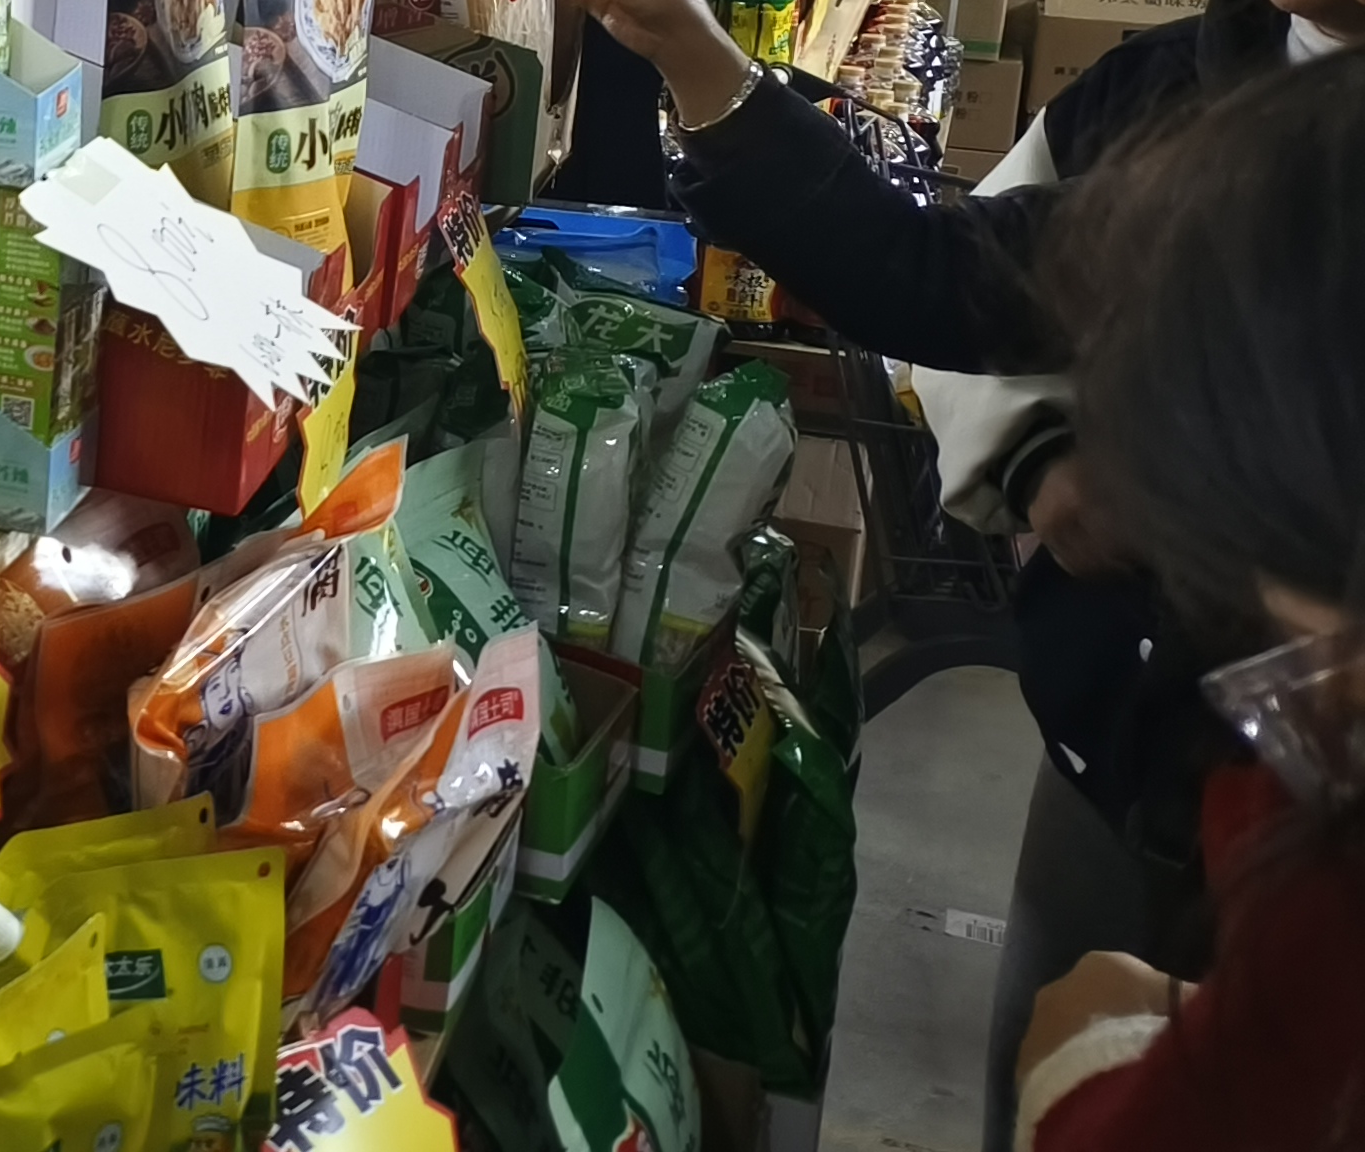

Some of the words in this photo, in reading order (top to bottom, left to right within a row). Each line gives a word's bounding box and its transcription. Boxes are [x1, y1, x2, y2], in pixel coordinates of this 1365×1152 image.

[129, 114, 150, 149] 传统
[269, 133, 289, 170] 传统
[271, 1024, 404, 1152] 特价
